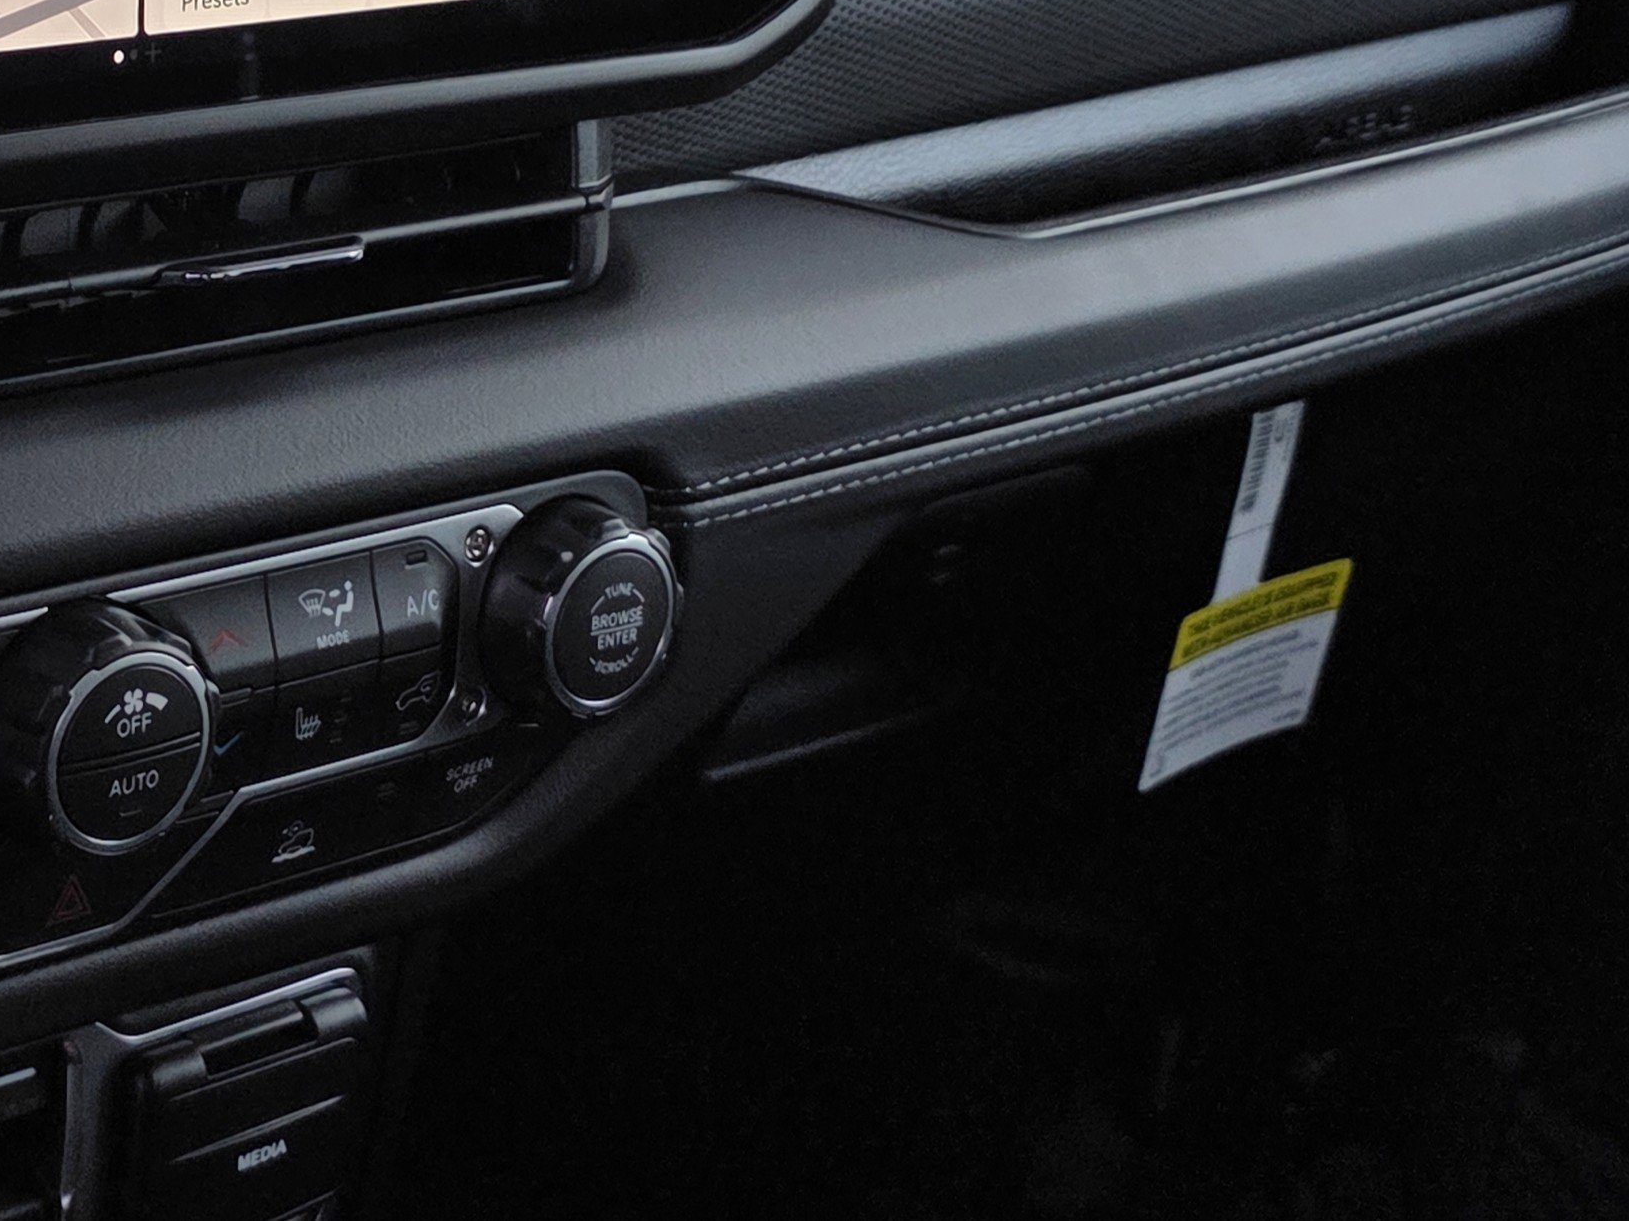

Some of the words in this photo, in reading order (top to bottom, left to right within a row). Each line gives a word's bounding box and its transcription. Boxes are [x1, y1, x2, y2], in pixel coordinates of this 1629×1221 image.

[406, 588, 439, 618] A/C
[604, 582, 635, 600] TUNE
[591, 605, 643, 631] BROWSE
[316, 629, 351, 651] MODE
[597, 627, 638, 650] ENTER
[116, 711, 152, 738] OFF
[446, 756, 494, 782] SCREEN
[108, 769, 159, 798] AUTO
[453, 774, 478, 793] OFF
[237, 1139, 288, 1172] MEDIA
